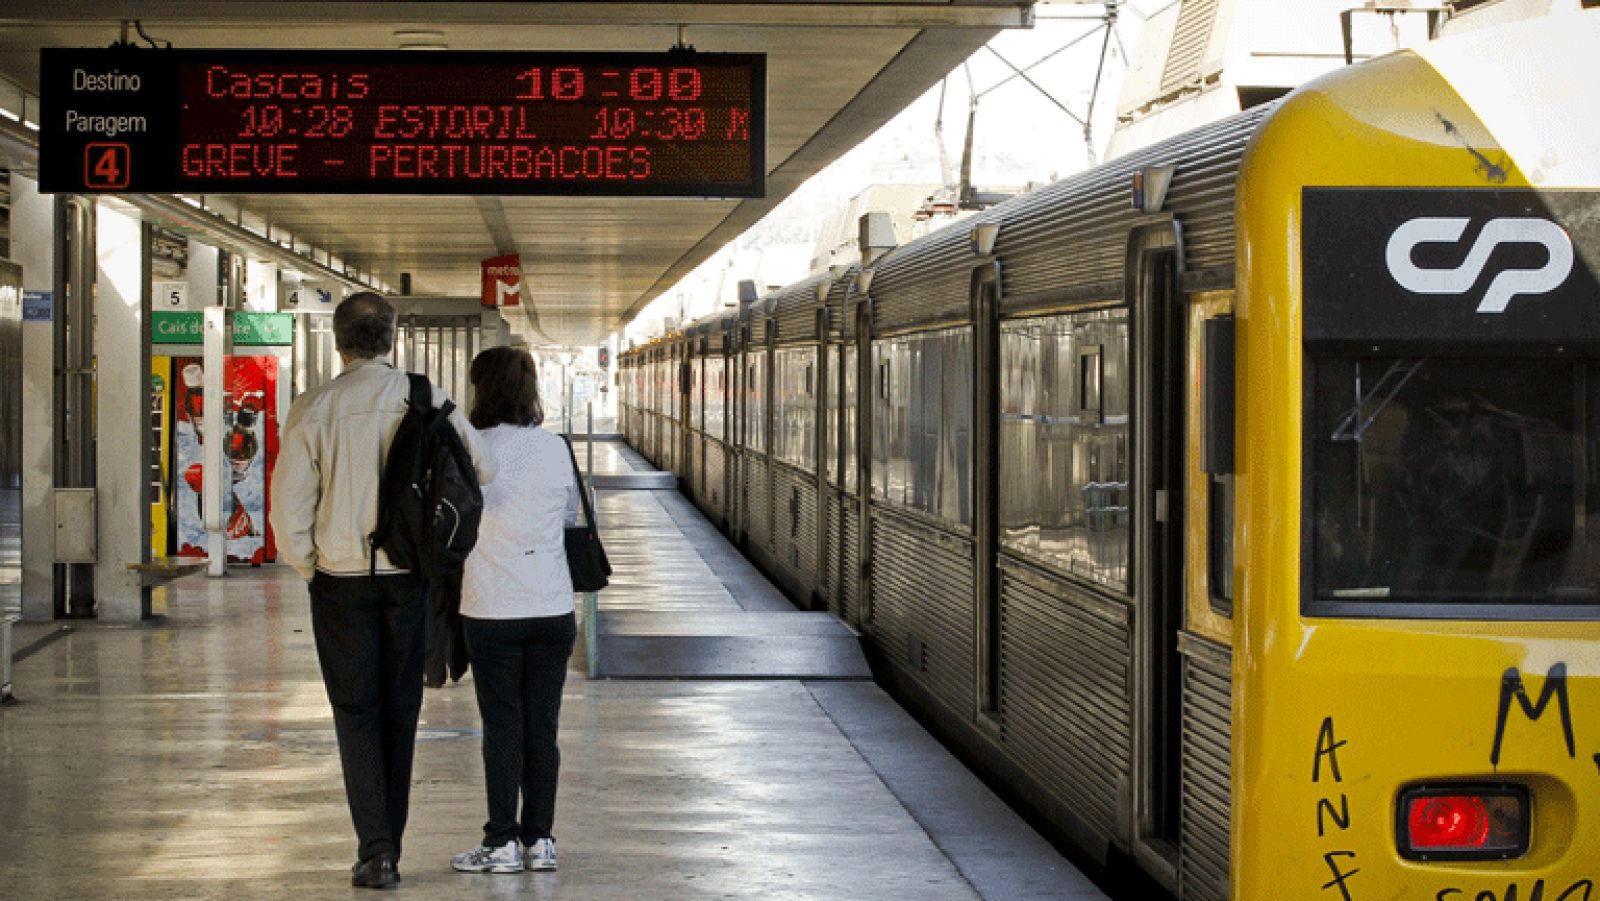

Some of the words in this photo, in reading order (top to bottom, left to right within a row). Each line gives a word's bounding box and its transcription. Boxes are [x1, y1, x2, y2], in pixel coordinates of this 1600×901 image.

[72, 68, 141, 92] Destino
[207, 66, 369, 98] Cascais
[515, 67, 702, 100] 10:00
[65, 109, 147, 137] Paragem
[238, 105, 352, 138] 10:28
[374, 106, 536, 139] ESTORIL
[591, 107, 706, 140] 10:30
[94, 148, 120, 183] 4
[183, 143, 298, 177] GREVE
[370, 145, 651, 179] PERTURBACOES
[170, 290, 181, 306] 5
[288, 290, 299, 304] 4
[157, 320, 188, 335] Cais
